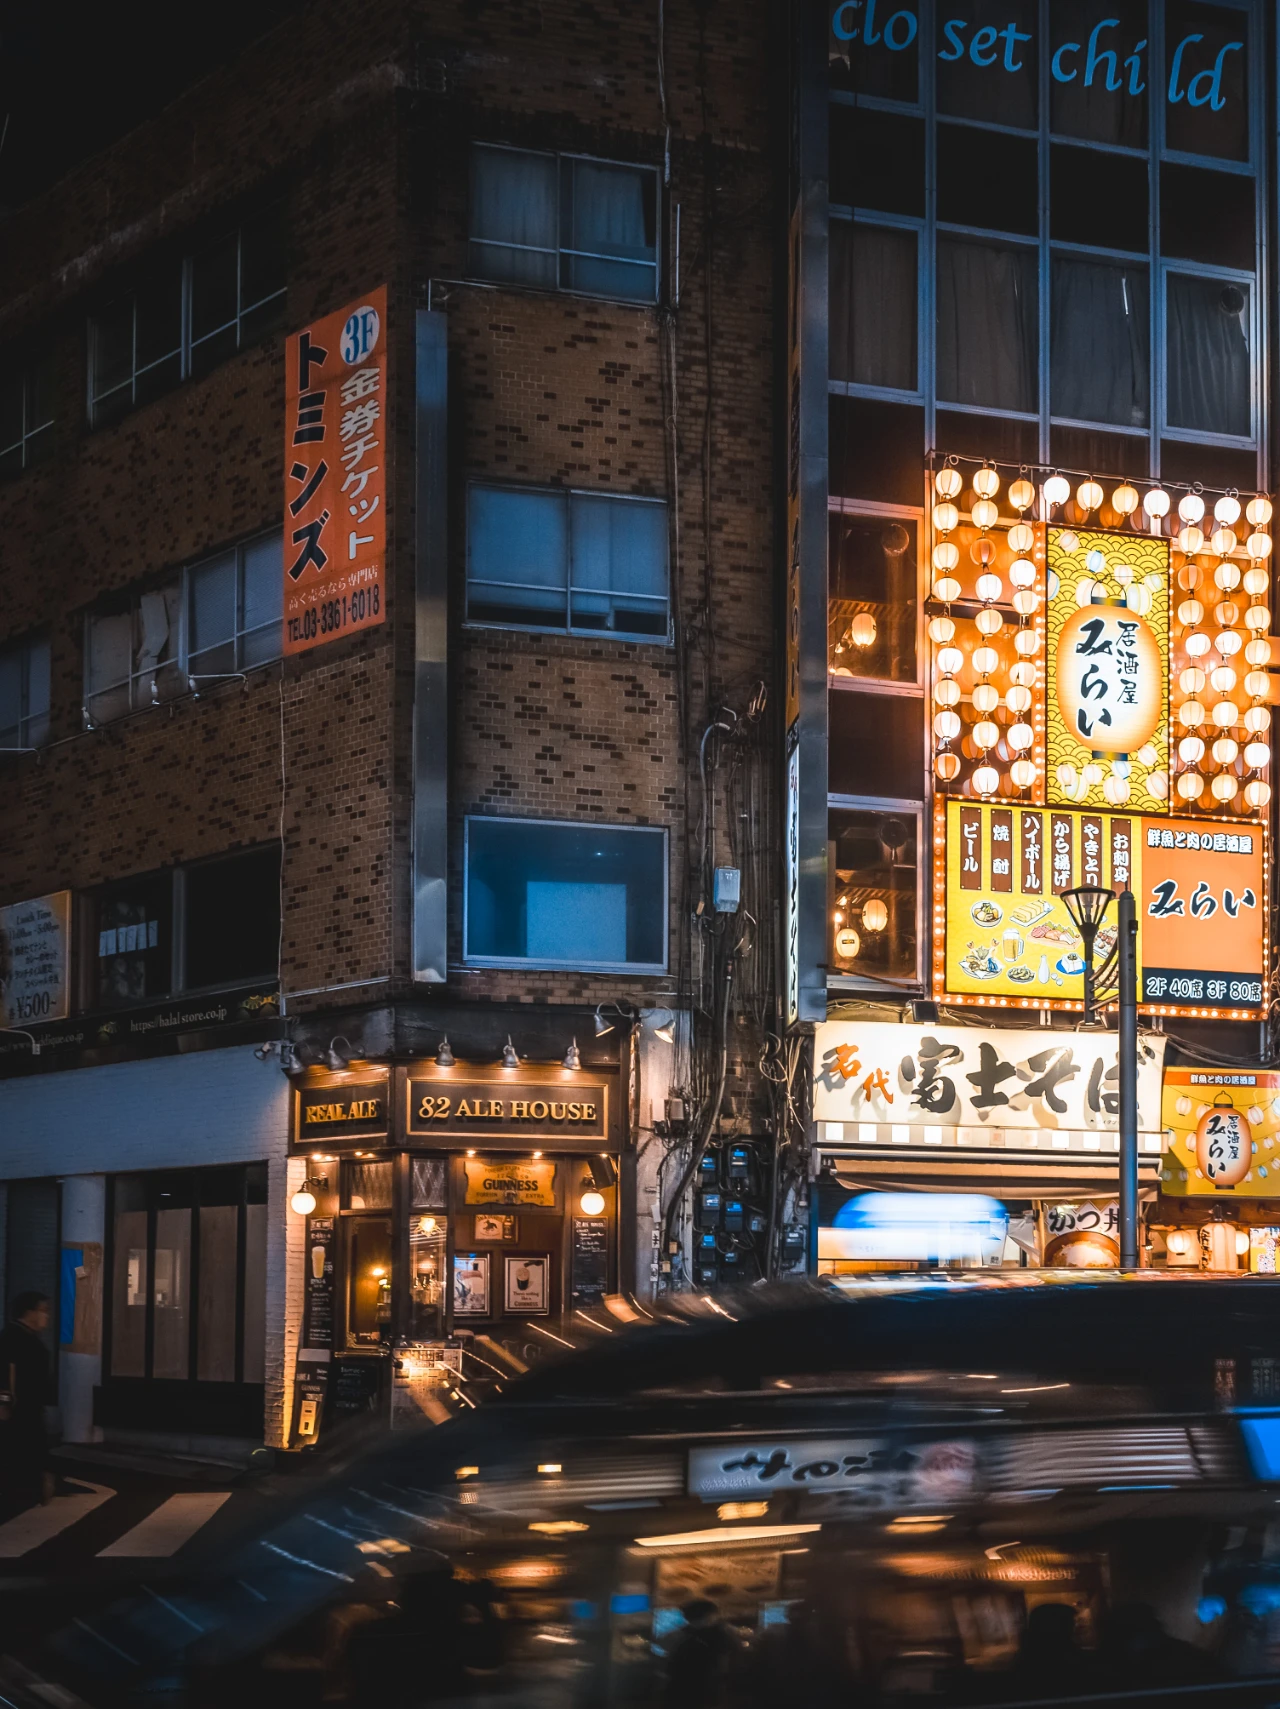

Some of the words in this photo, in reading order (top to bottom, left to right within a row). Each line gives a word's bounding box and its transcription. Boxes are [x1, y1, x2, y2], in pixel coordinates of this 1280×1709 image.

[344, 313, 376, 364] 3F
[287, 330, 331, 583] トミンズ
[339, 367, 381, 560] 金券チケット
[1075, 617, 1113, 738] みらい
[1115, 619, 1140, 705] 居酒屋
[962, 821, 979, 873] ビール
[992, 823, 1010, 876] 焼酎
[1023, 815, 1040, 889] ハイボール
[1053, 820, 1071, 887] から揚げ
[1083, 822, 1100, 887] やきとり
[1112, 832, 1130, 883] お刺身
[1147, 827, 1253, 855] 鮮魚と肉の居酒屋
[1148, 878, 1257, 920] みらい
[1148, 977, 1166, 996] 2F
[1170, 979, 1204, 999] 40席
[1207, 980, 1227, 999] 3F
[1230, 981, 1262, 1002] 80席
[832, 1042, 895, 1105] 名代
[900, 1035, 1156, 1115] 富士そば
[1190, 1073, 1257, 1086] 鮮魚と肉の居酒屋
[305, 1103, 343, 1124] REAL
[348, 1099, 378, 1120] ALE
[417, 1096, 451, 1120] 82
[455, 1099, 504, 1119] ALE
[510, 1101, 597, 1121] HOUSE
[1206, 1114, 1228, 1179] みらい
[1227, 1114, 1241, 1160] 居酒屋
[482, 1178, 539, 1191] GUINNESS
